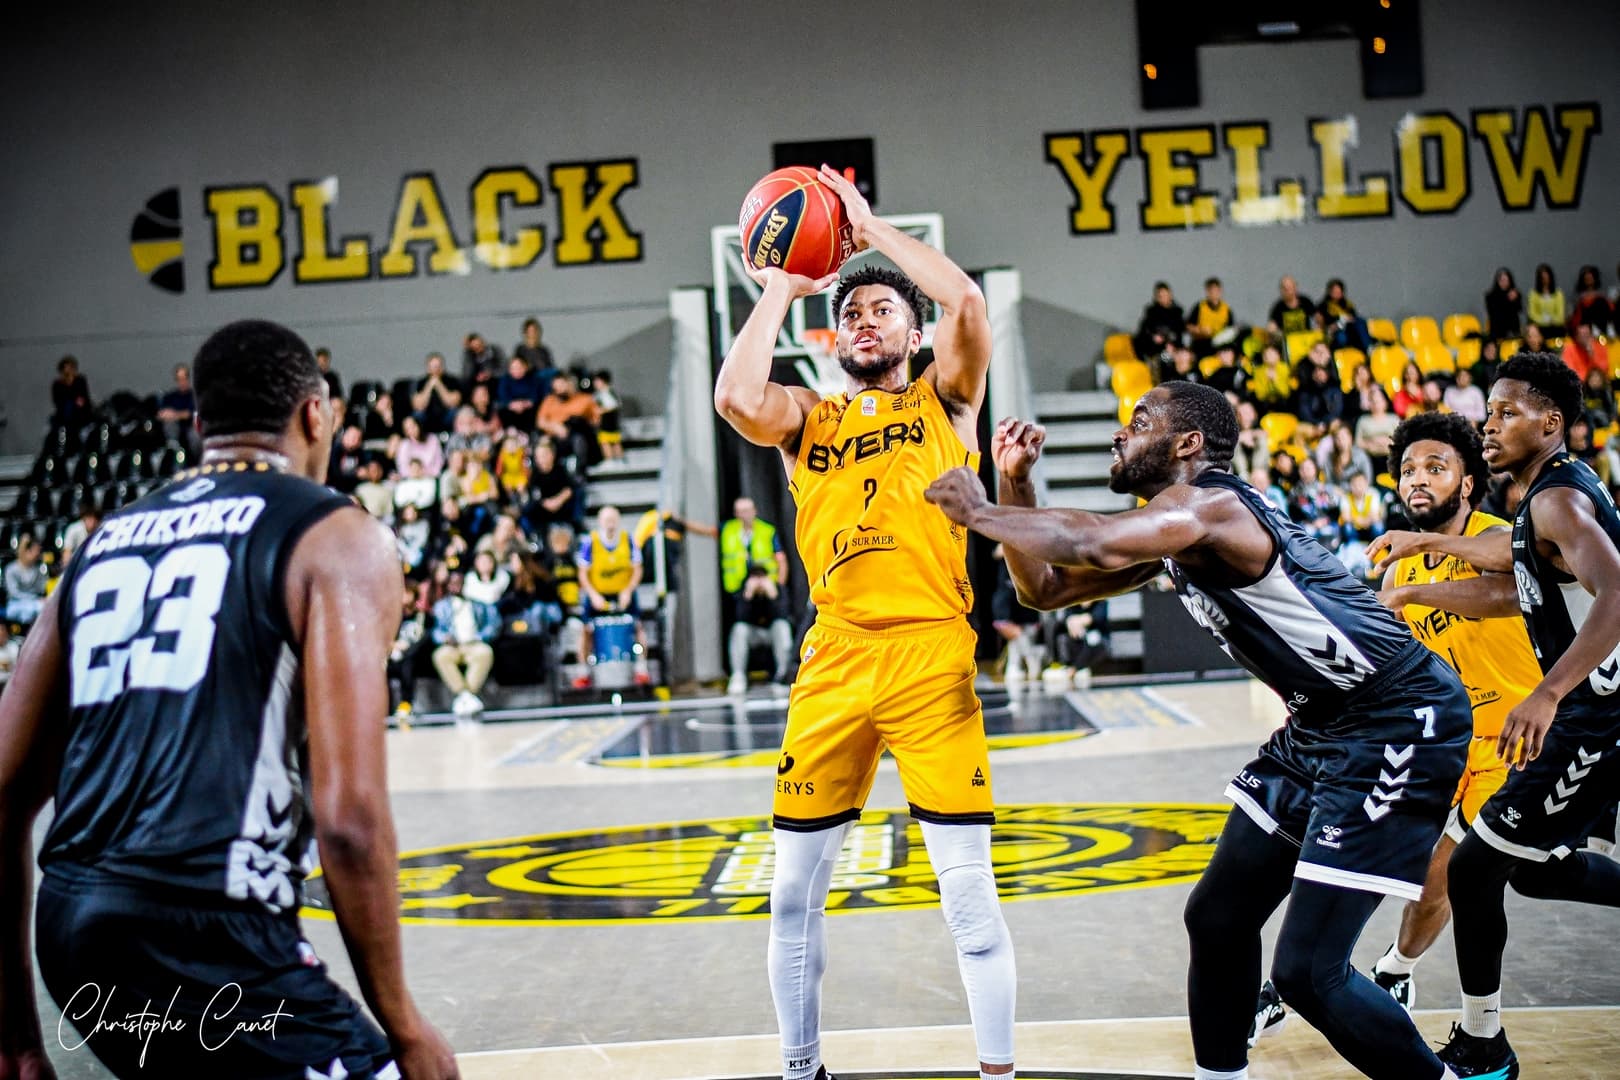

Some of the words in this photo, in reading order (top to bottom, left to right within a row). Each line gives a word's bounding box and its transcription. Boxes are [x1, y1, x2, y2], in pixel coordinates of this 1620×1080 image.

[1044, 103, 1601, 236] YELLOW
[204, 157, 644, 290] BLACK
[85, 496, 266, 558] CHIKOKO
[852, 537, 870, 546] SUR
[872, 535, 895, 545] MER
[70, 543, 231, 707] 23
[1414, 706, 1436, 738] 7
[777, 779, 815, 795] ERYS
[1239, 769, 1262, 789] LIS
